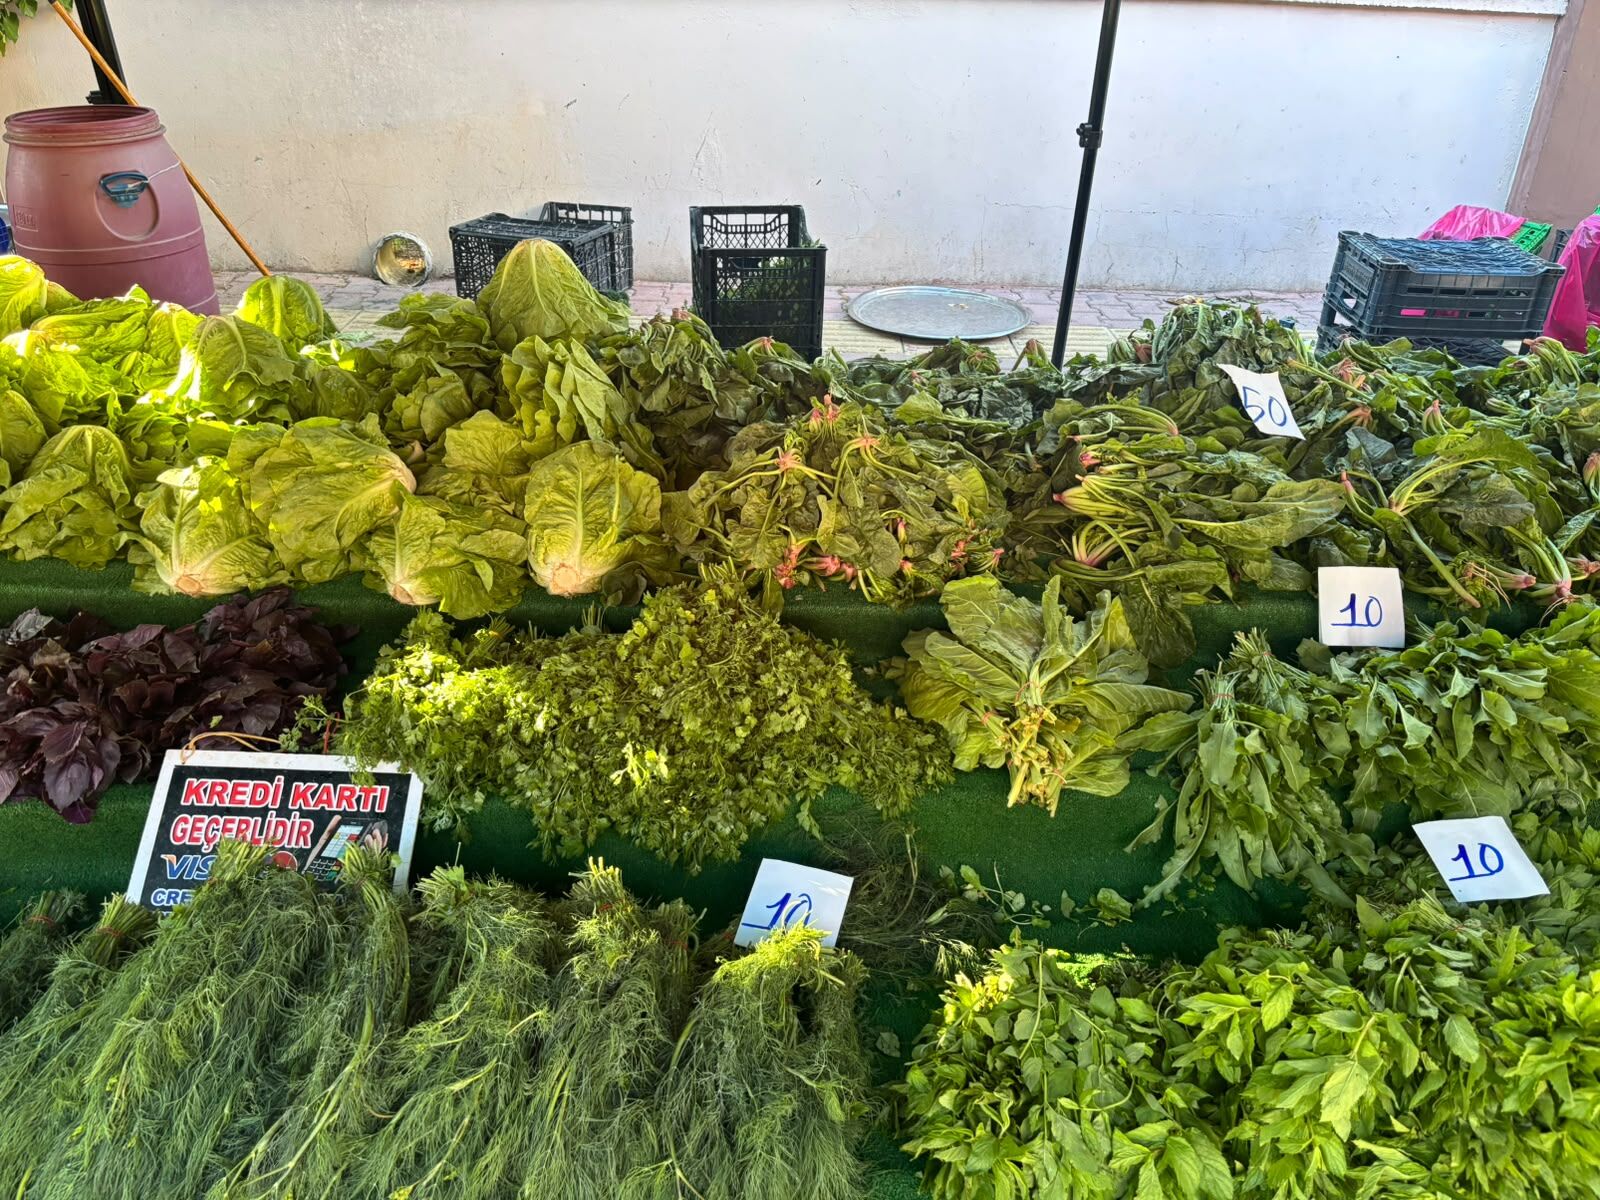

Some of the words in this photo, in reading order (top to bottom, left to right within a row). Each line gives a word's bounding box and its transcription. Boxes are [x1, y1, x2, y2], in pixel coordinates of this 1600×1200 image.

[1242, 386, 1287, 427] 50
[1330, 593, 1383, 627] 10
[182, 776, 284, 807] KREDİ
[290, 783, 389, 812] KARTI
[171, 811, 314, 852] GEÇERLİDİR
[160, 854, 217, 880] VIS
[1449, 843, 1504, 881] 10
[151, 888, 195, 906] CRE
[742, 892, 813, 931] 10
